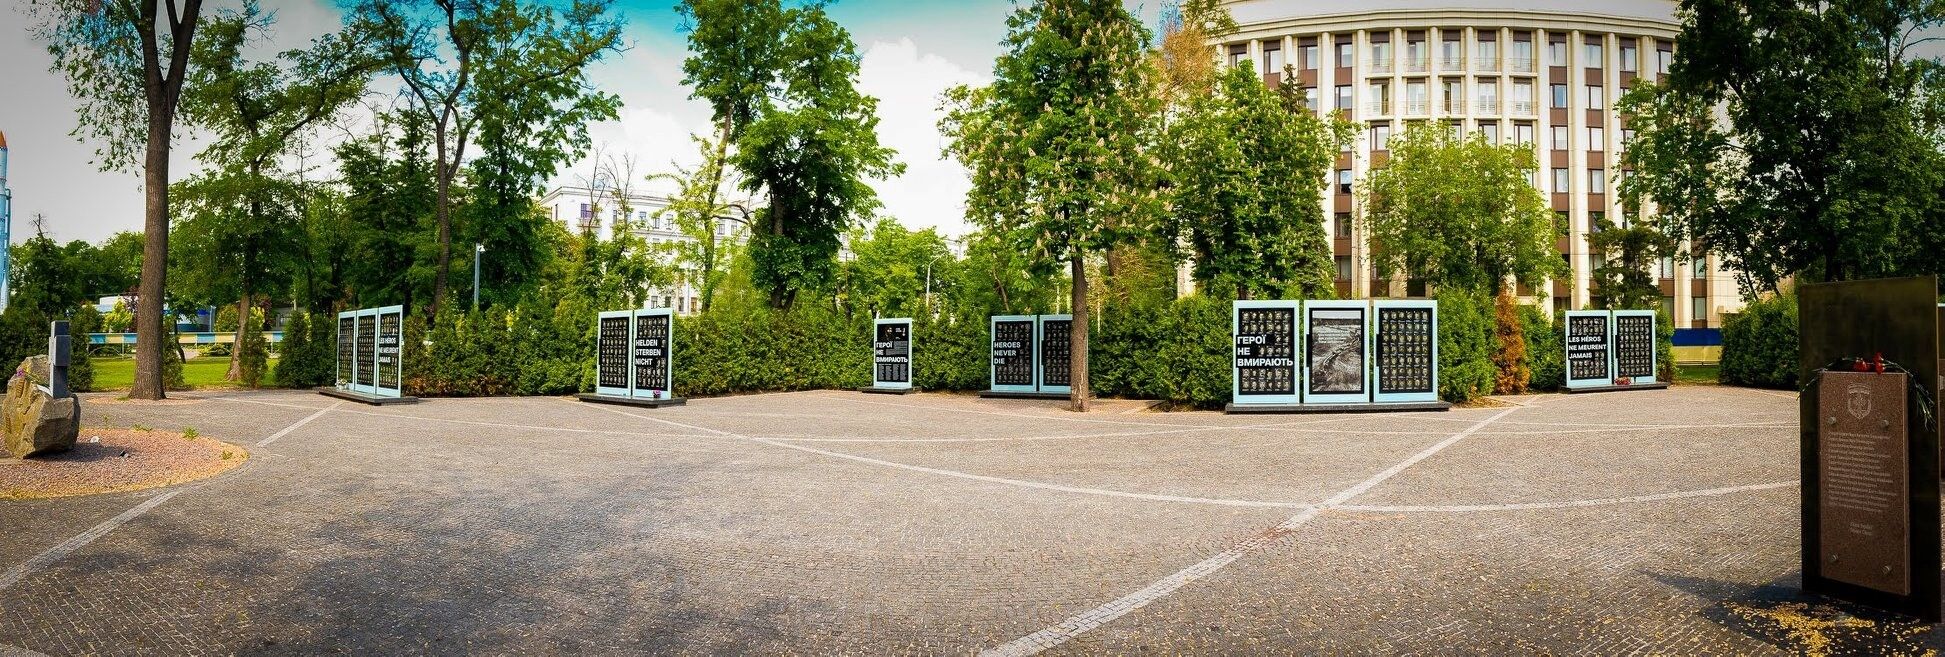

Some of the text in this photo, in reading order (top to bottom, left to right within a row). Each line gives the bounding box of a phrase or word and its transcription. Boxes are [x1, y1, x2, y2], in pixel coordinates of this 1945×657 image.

[635, 339, 658, 347] HELDEN
[1237, 334, 1267, 345] ГЕРОЇ
[635, 348, 661, 356] STERBEN
[1237, 347, 1251, 356] НЕ
[635, 358, 653, 366] NICHT
[993, 357, 1006, 365] DIE
[1237, 358, 1294, 367] ВМИРАЮТЬ
